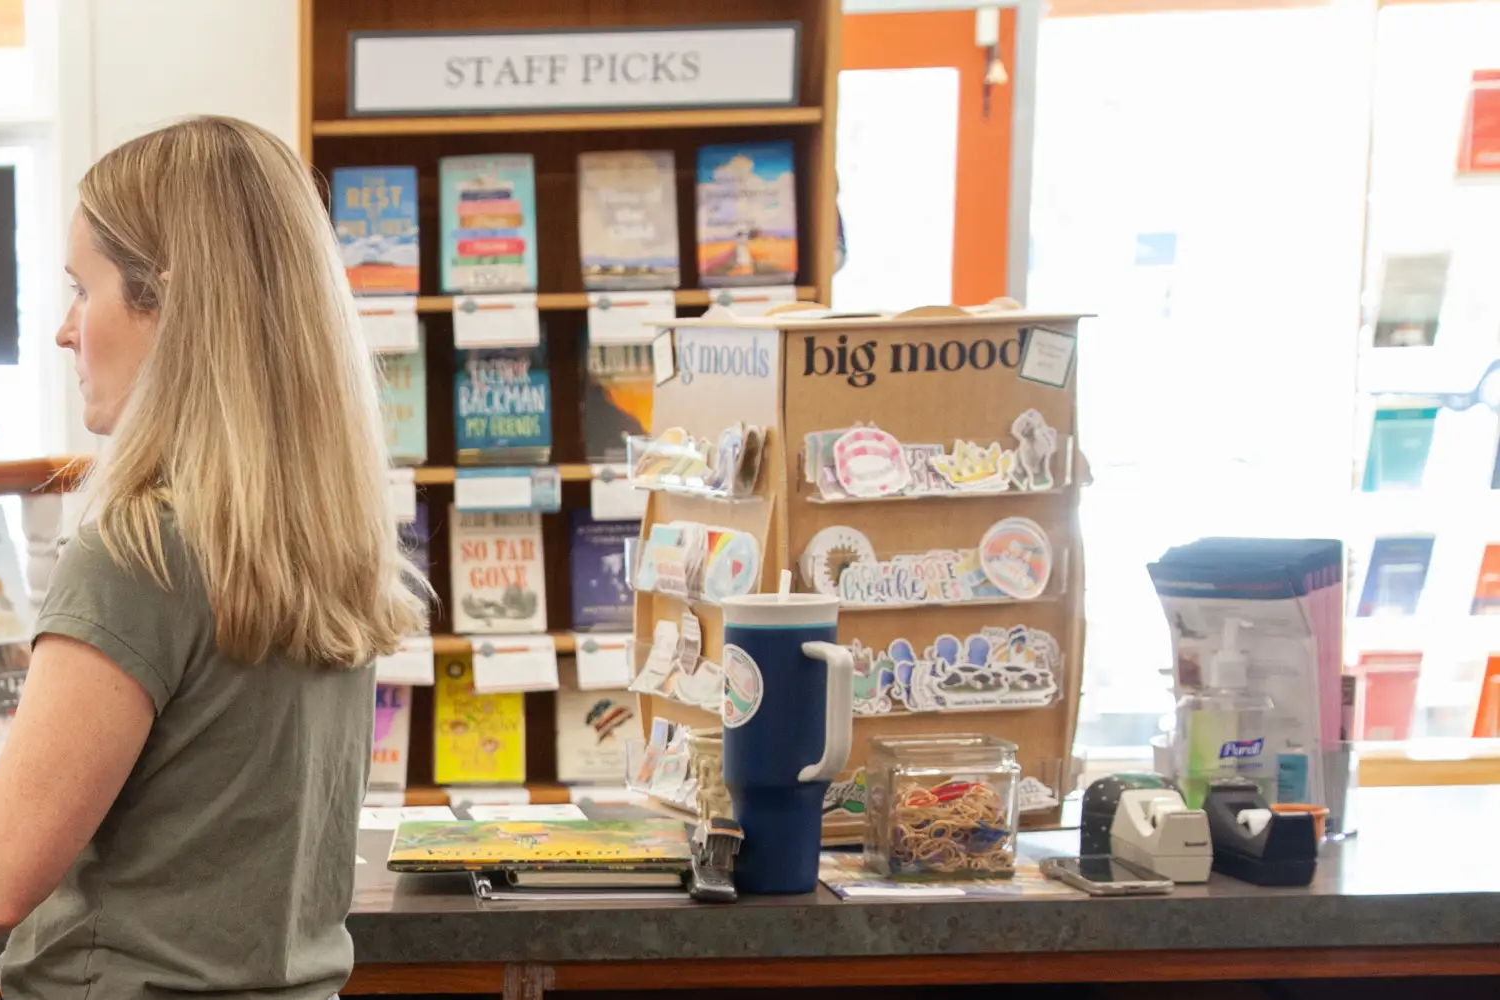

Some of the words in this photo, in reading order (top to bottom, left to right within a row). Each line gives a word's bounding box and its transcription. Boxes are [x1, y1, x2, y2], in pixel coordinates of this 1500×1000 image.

[443, 54, 567, 89] STAFF
[580, 50, 700, 85] PICKS
[677, 333, 695, 386] ig
[699, 336, 769, 378] moods
[803, 334, 878, 388] big
[889, 327, 1029, 374] mood
[460, 539, 488, 562] SO
[494, 537, 535, 561] FAR
[469, 565, 529, 590] GONE
[841, 563, 926, 602] breathe
[1223, 740, 1260, 758] Purell
